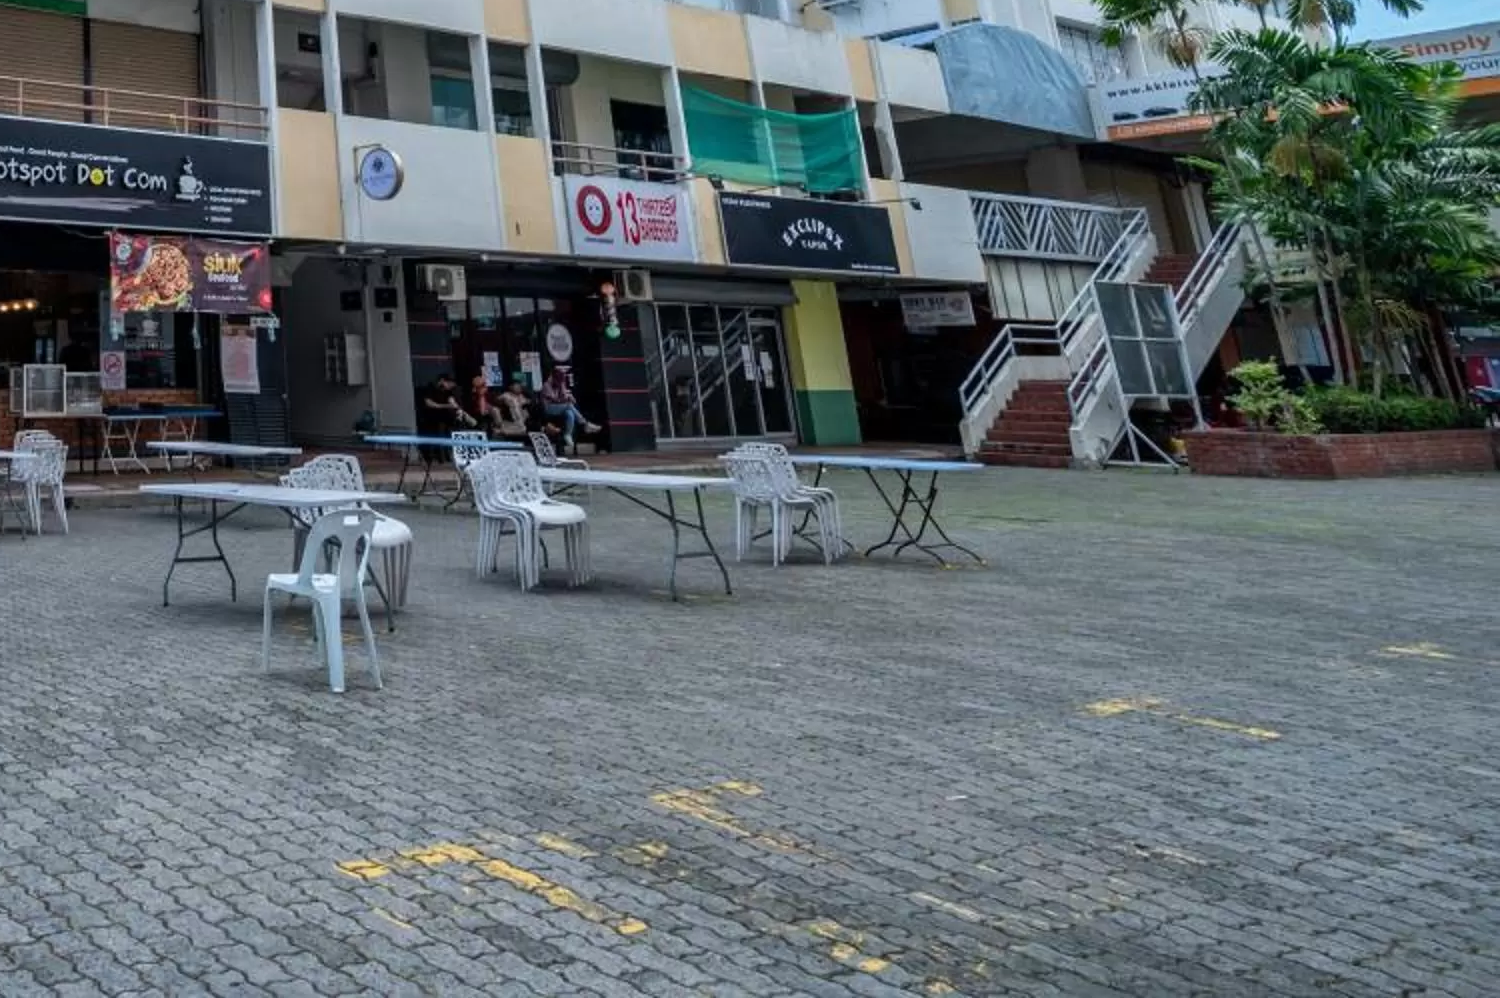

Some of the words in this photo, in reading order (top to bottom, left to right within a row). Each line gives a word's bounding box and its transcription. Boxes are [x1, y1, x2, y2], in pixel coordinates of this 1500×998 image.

[1401, 33, 1492, 57] Simply
[77, 163, 115, 186] Dot
[123, 167, 168, 191] Com
[616, 191, 640, 245] 13
